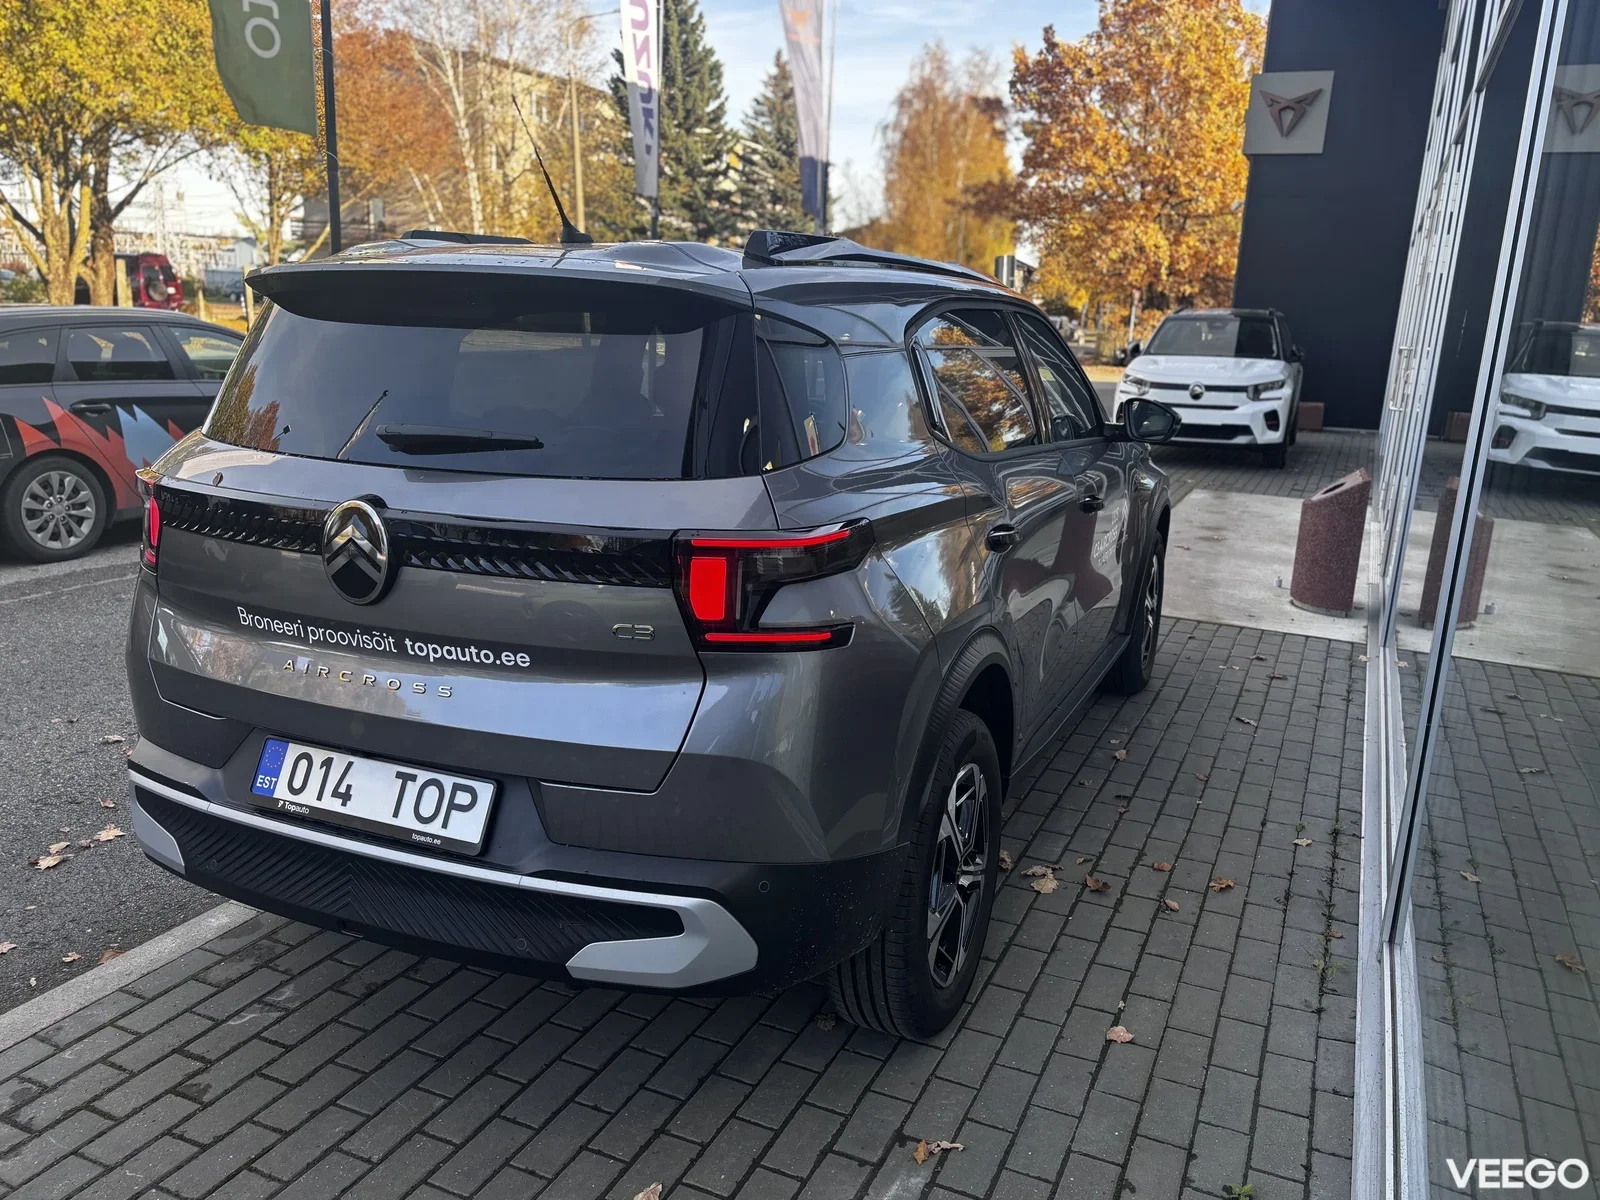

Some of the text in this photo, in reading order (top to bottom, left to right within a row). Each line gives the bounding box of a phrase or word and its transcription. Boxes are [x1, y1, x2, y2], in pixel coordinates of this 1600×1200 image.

[237, 606, 531, 667] Broneeri proovisõit topauto.ee
[612, 623, 655, 641] C3
[283, 659, 453, 698] AIRCROSS
[256, 775, 278, 790] EST
[287, 751, 479, 830] 014 TOP
[284, 801, 310, 815] Topauto
[411, 832, 442, 846] topauto.ee
